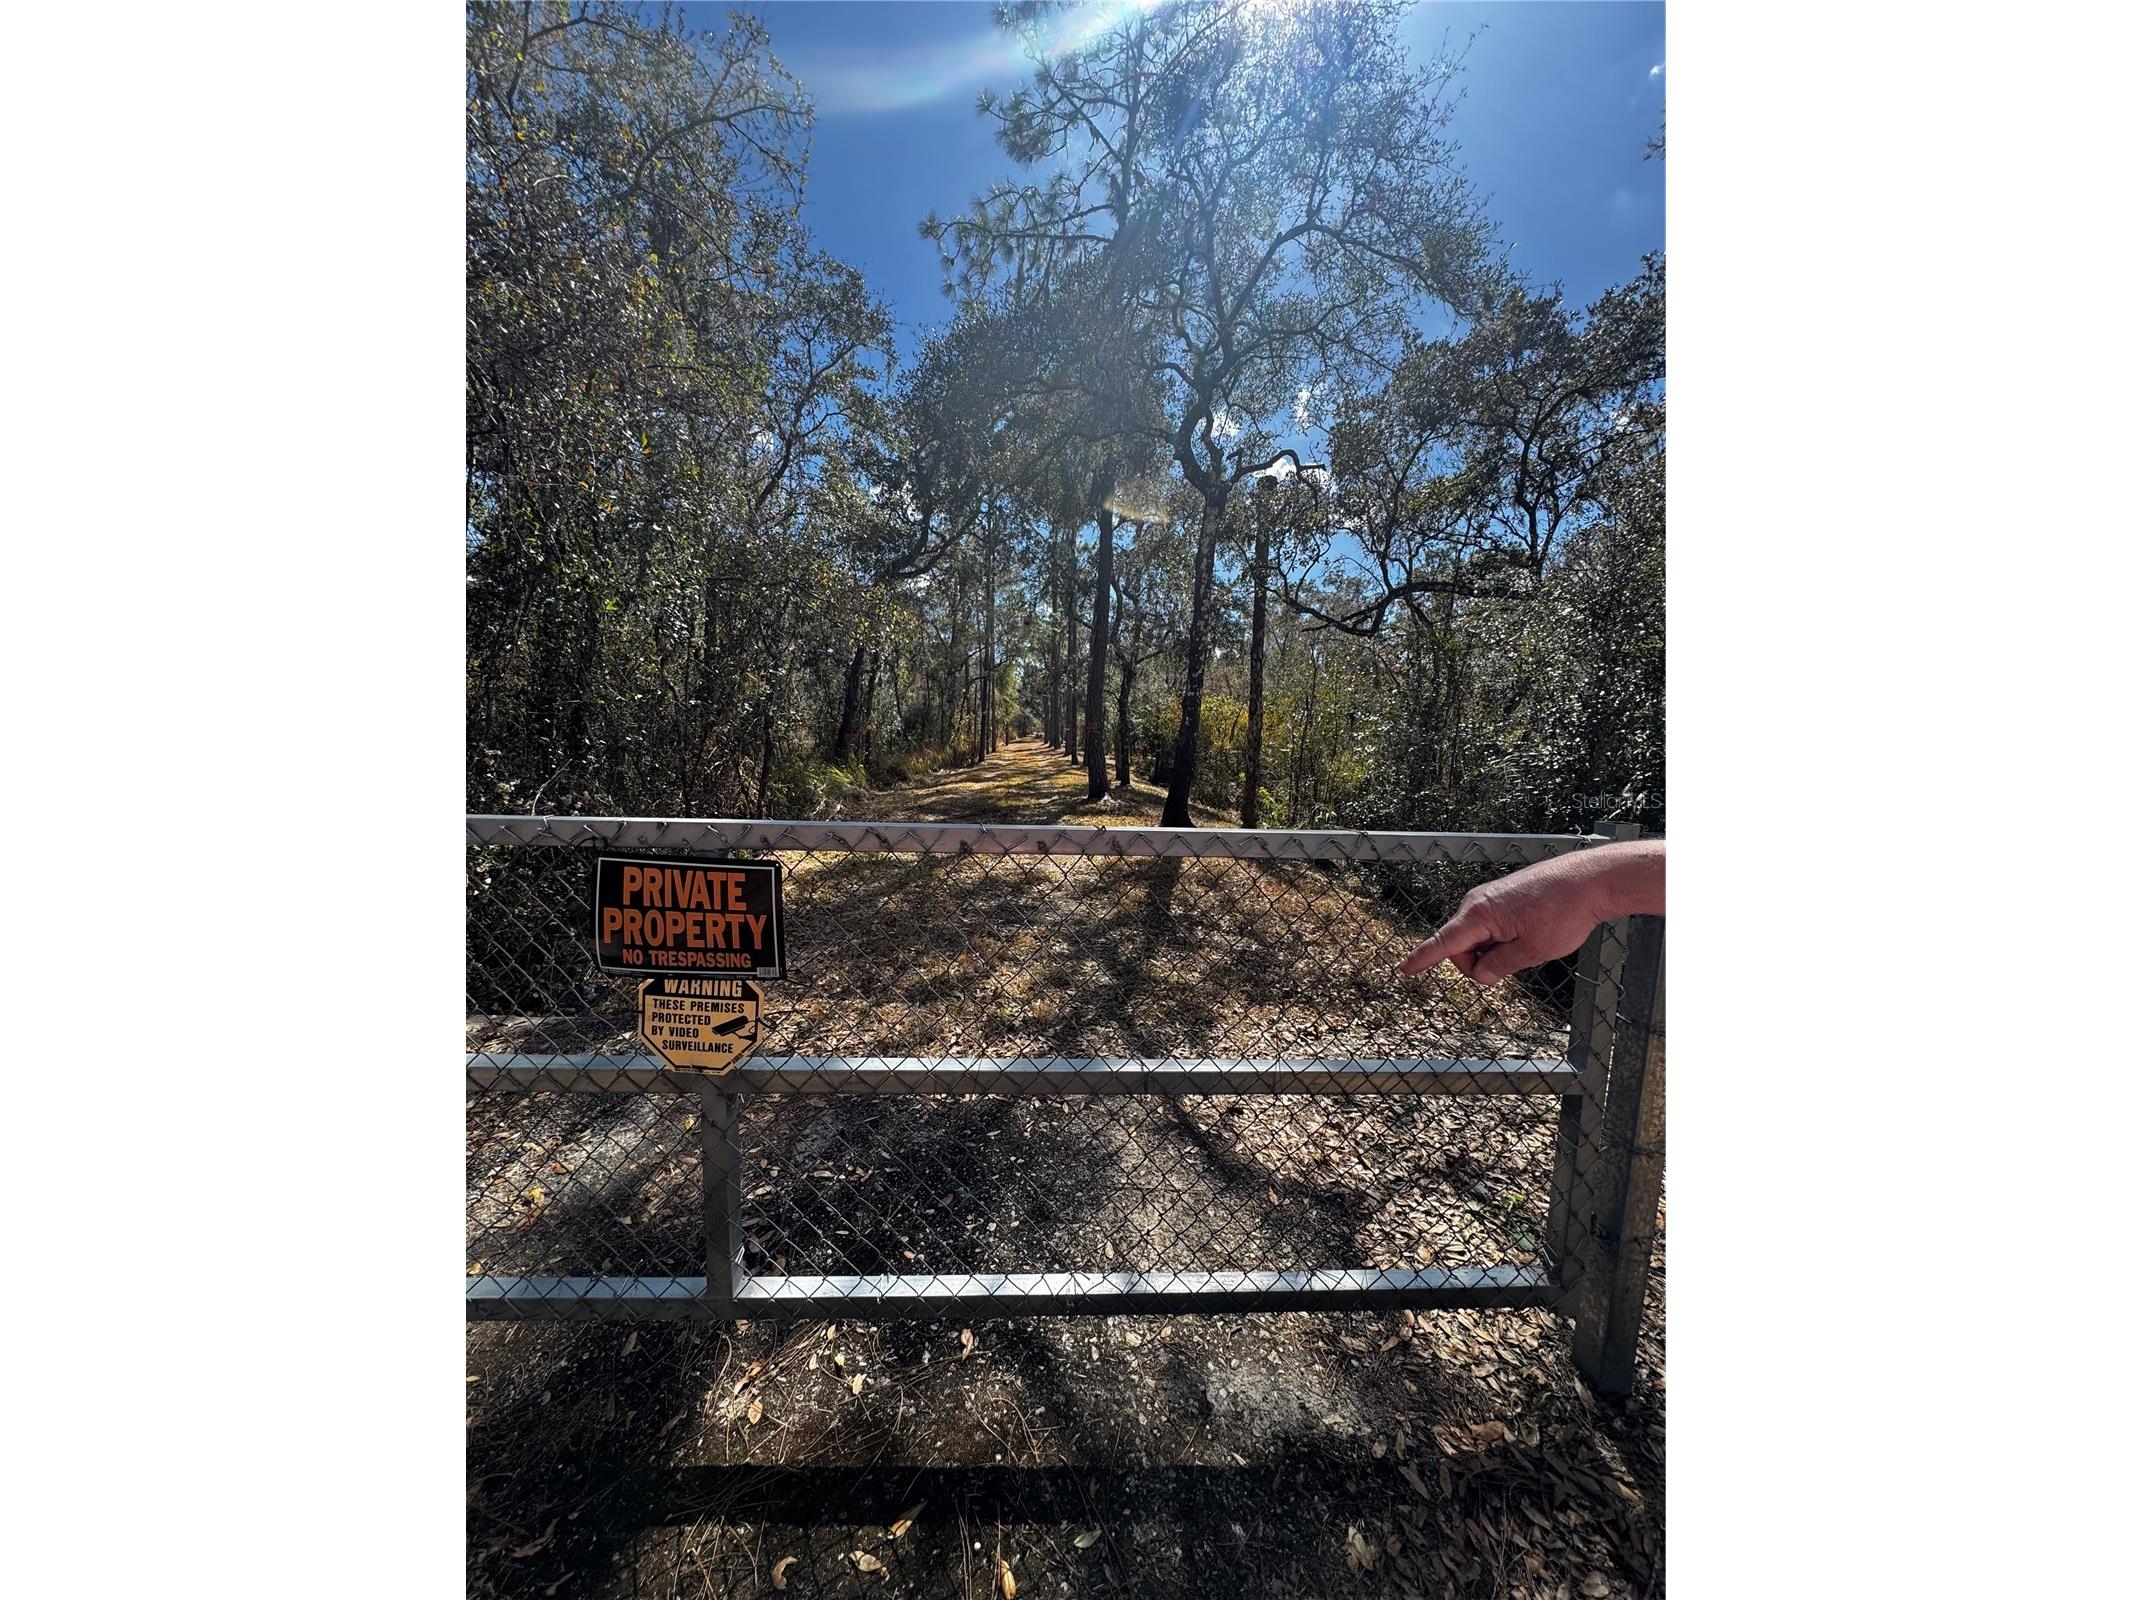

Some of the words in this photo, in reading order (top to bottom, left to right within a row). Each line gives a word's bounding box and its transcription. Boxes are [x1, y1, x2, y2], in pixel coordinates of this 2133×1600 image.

[622, 866, 747, 911] PRIVATE
[603, 907, 767, 950] PROPERTY
[622, 949, 644, 965] NO
[649, 950, 752, 968] TRESPASSING
[664, 979, 742, 998] WARNING
[652, 998, 685, 1011] THESE
[690, 1001, 745, 1013] PREMISES
[652, 1012, 711, 1025] PROTECTED
[651, 1026, 664, 1037] BY
[669, 1027, 699, 1038] VIDEO
[662, 1039, 733, 1054] SURVEILLANCE
